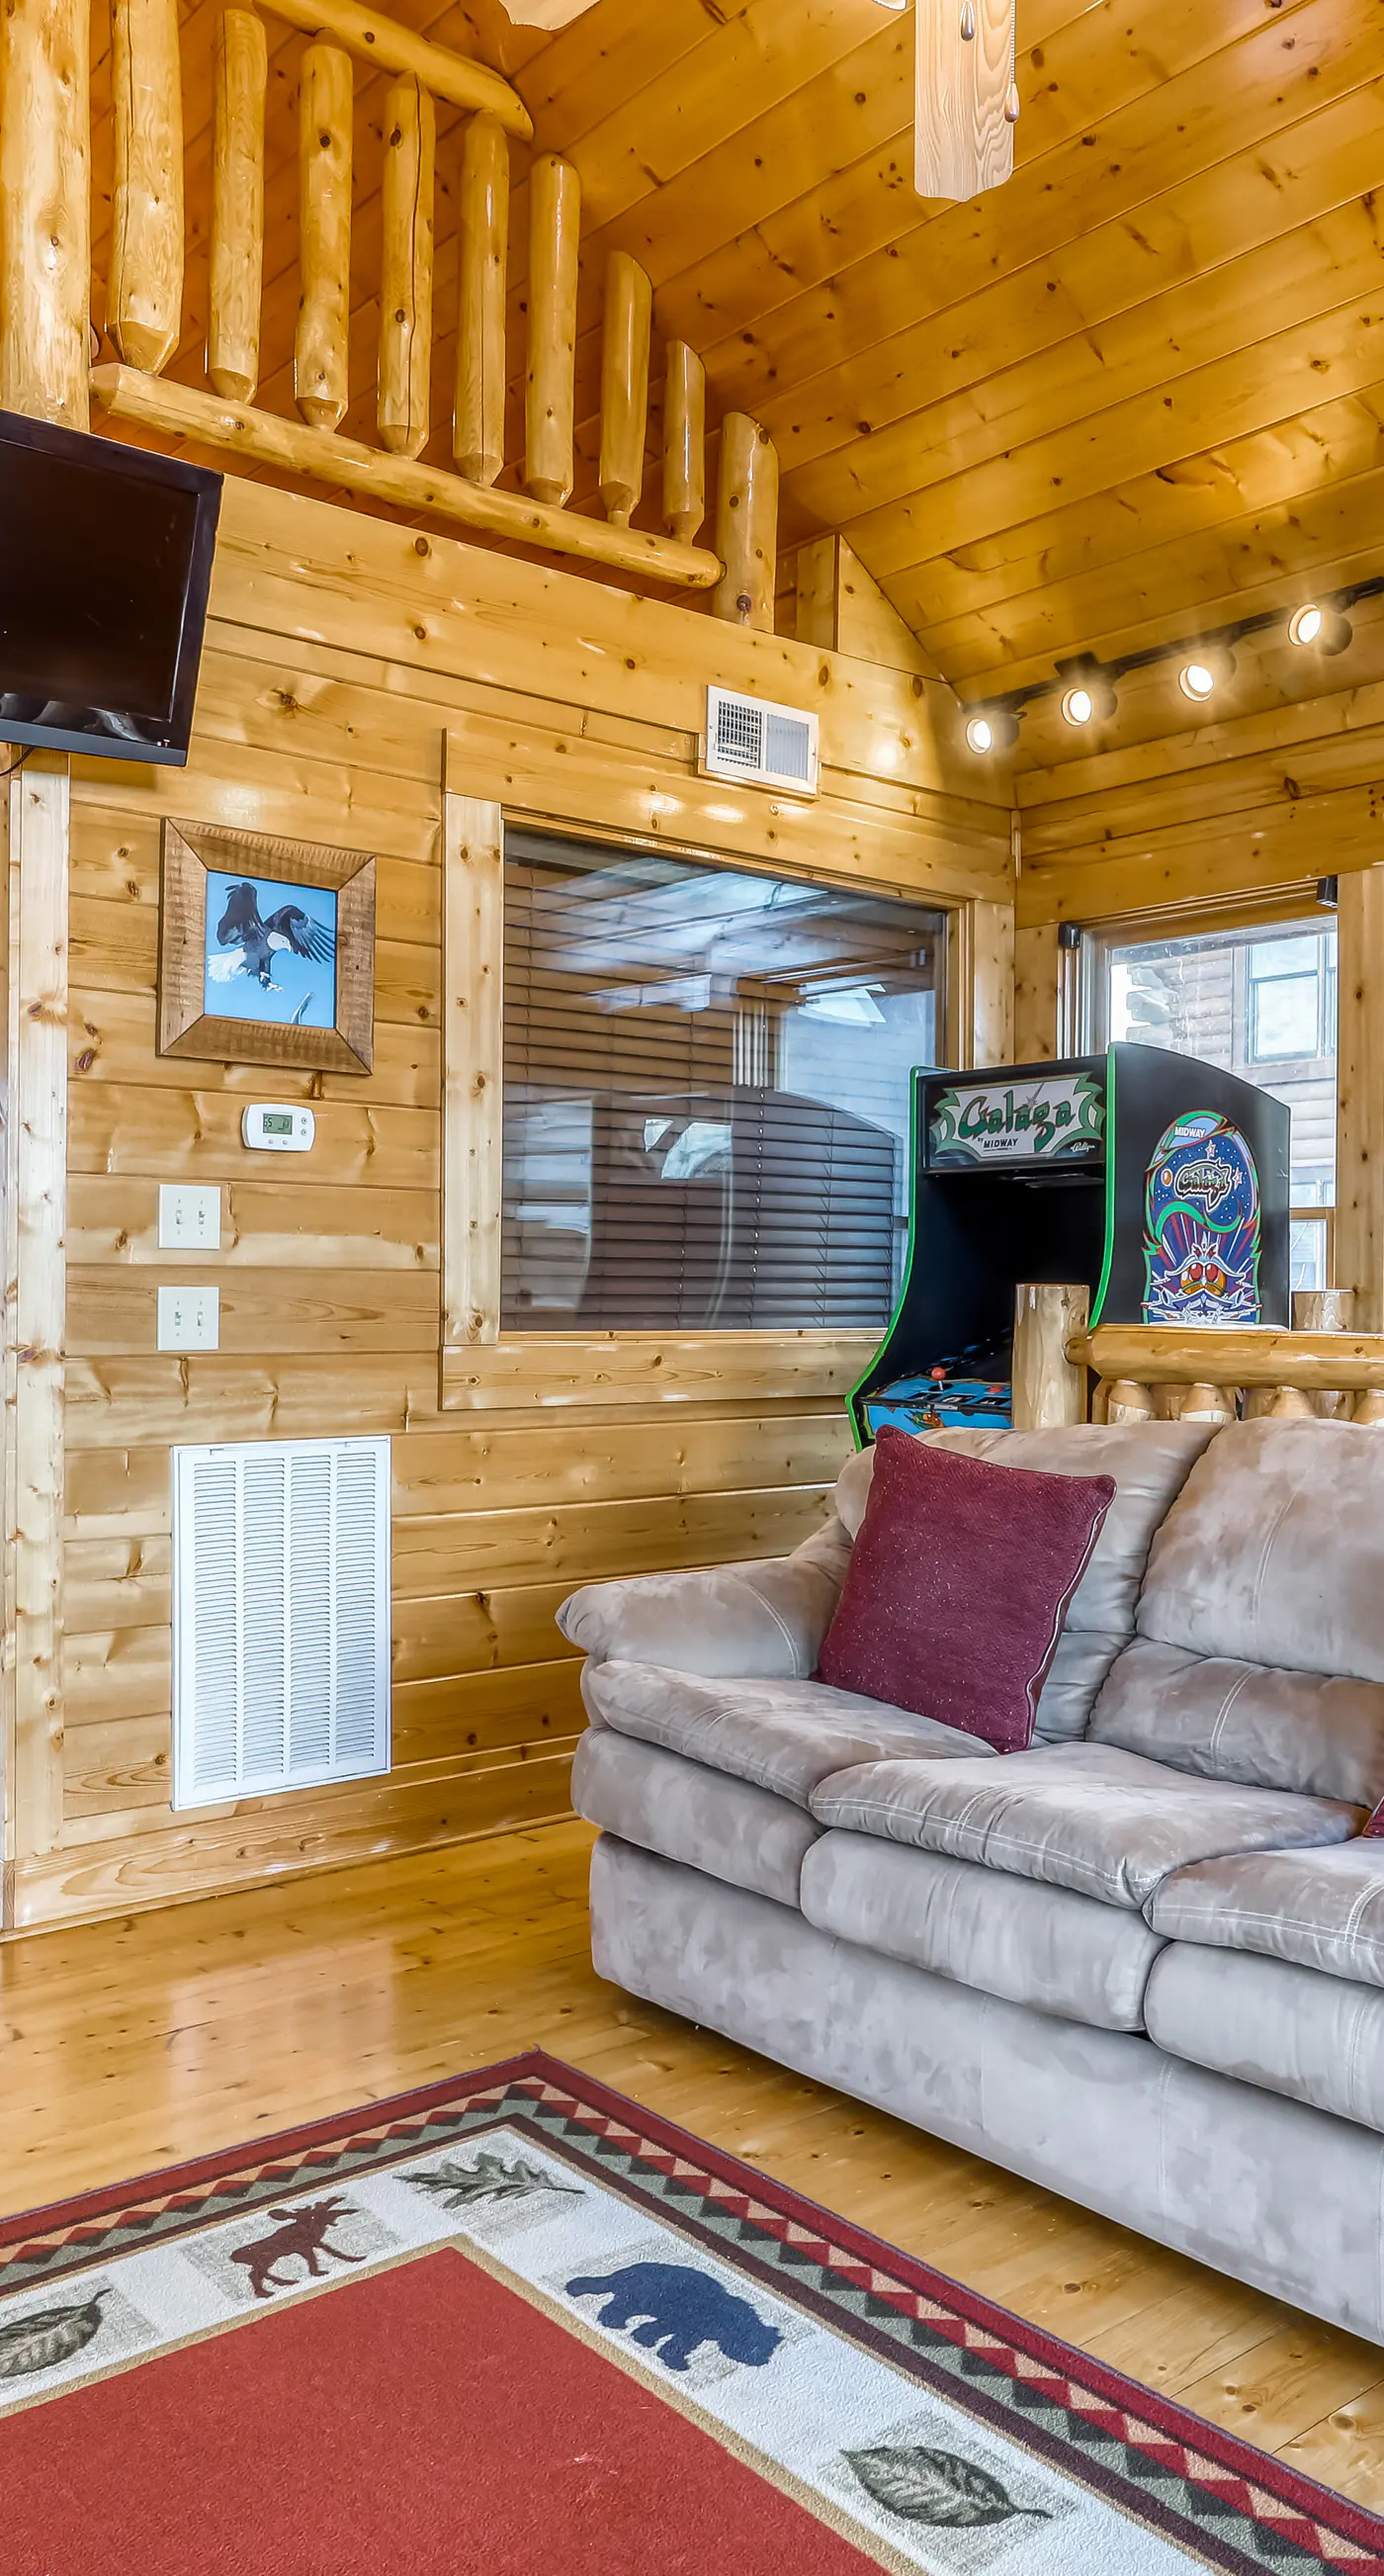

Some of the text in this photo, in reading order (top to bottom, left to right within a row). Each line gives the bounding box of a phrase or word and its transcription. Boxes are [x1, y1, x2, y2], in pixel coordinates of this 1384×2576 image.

[958, 1090, 1076, 1152] Galaga
[1174, 1126, 1205, 1138] MIDWAY
[984, 1138, 1018, 1148] MIDWAY
